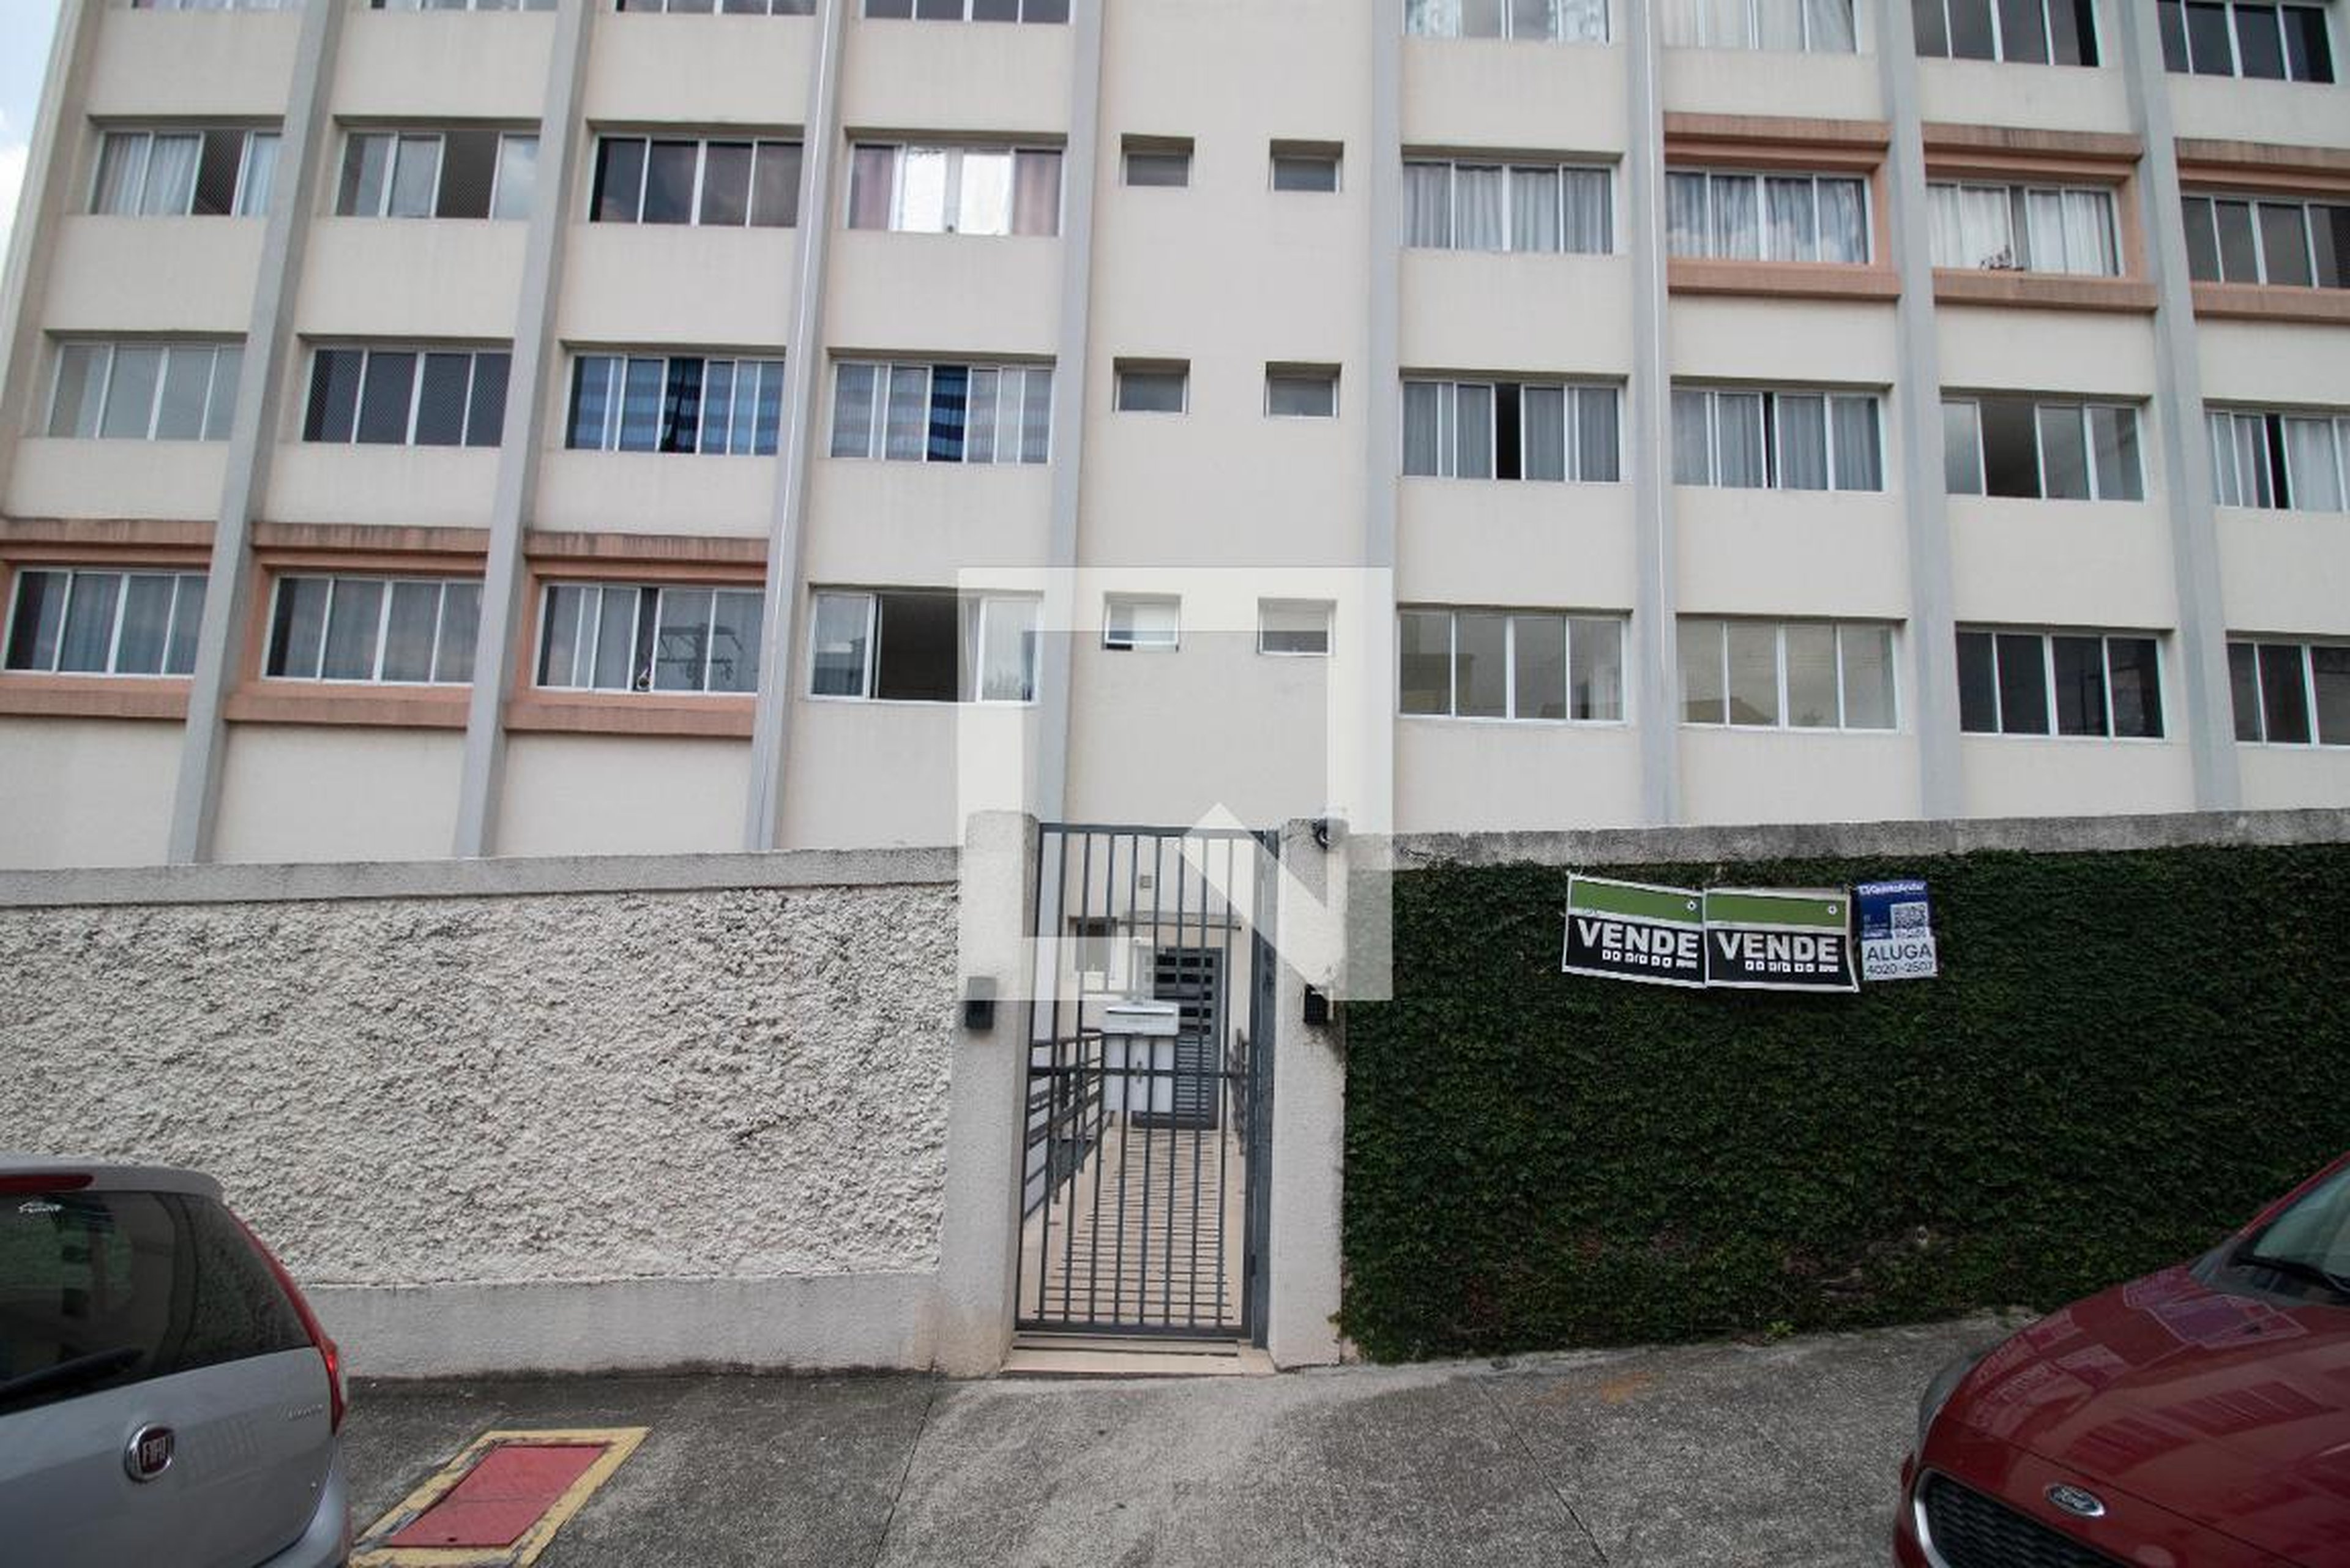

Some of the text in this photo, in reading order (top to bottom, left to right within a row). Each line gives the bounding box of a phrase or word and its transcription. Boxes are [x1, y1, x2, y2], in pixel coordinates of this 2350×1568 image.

[1577, 918, 1699, 958] VENDE
[1716, 930, 1838, 963] VENDE
[1867, 943, 1933, 961] ALUGA
